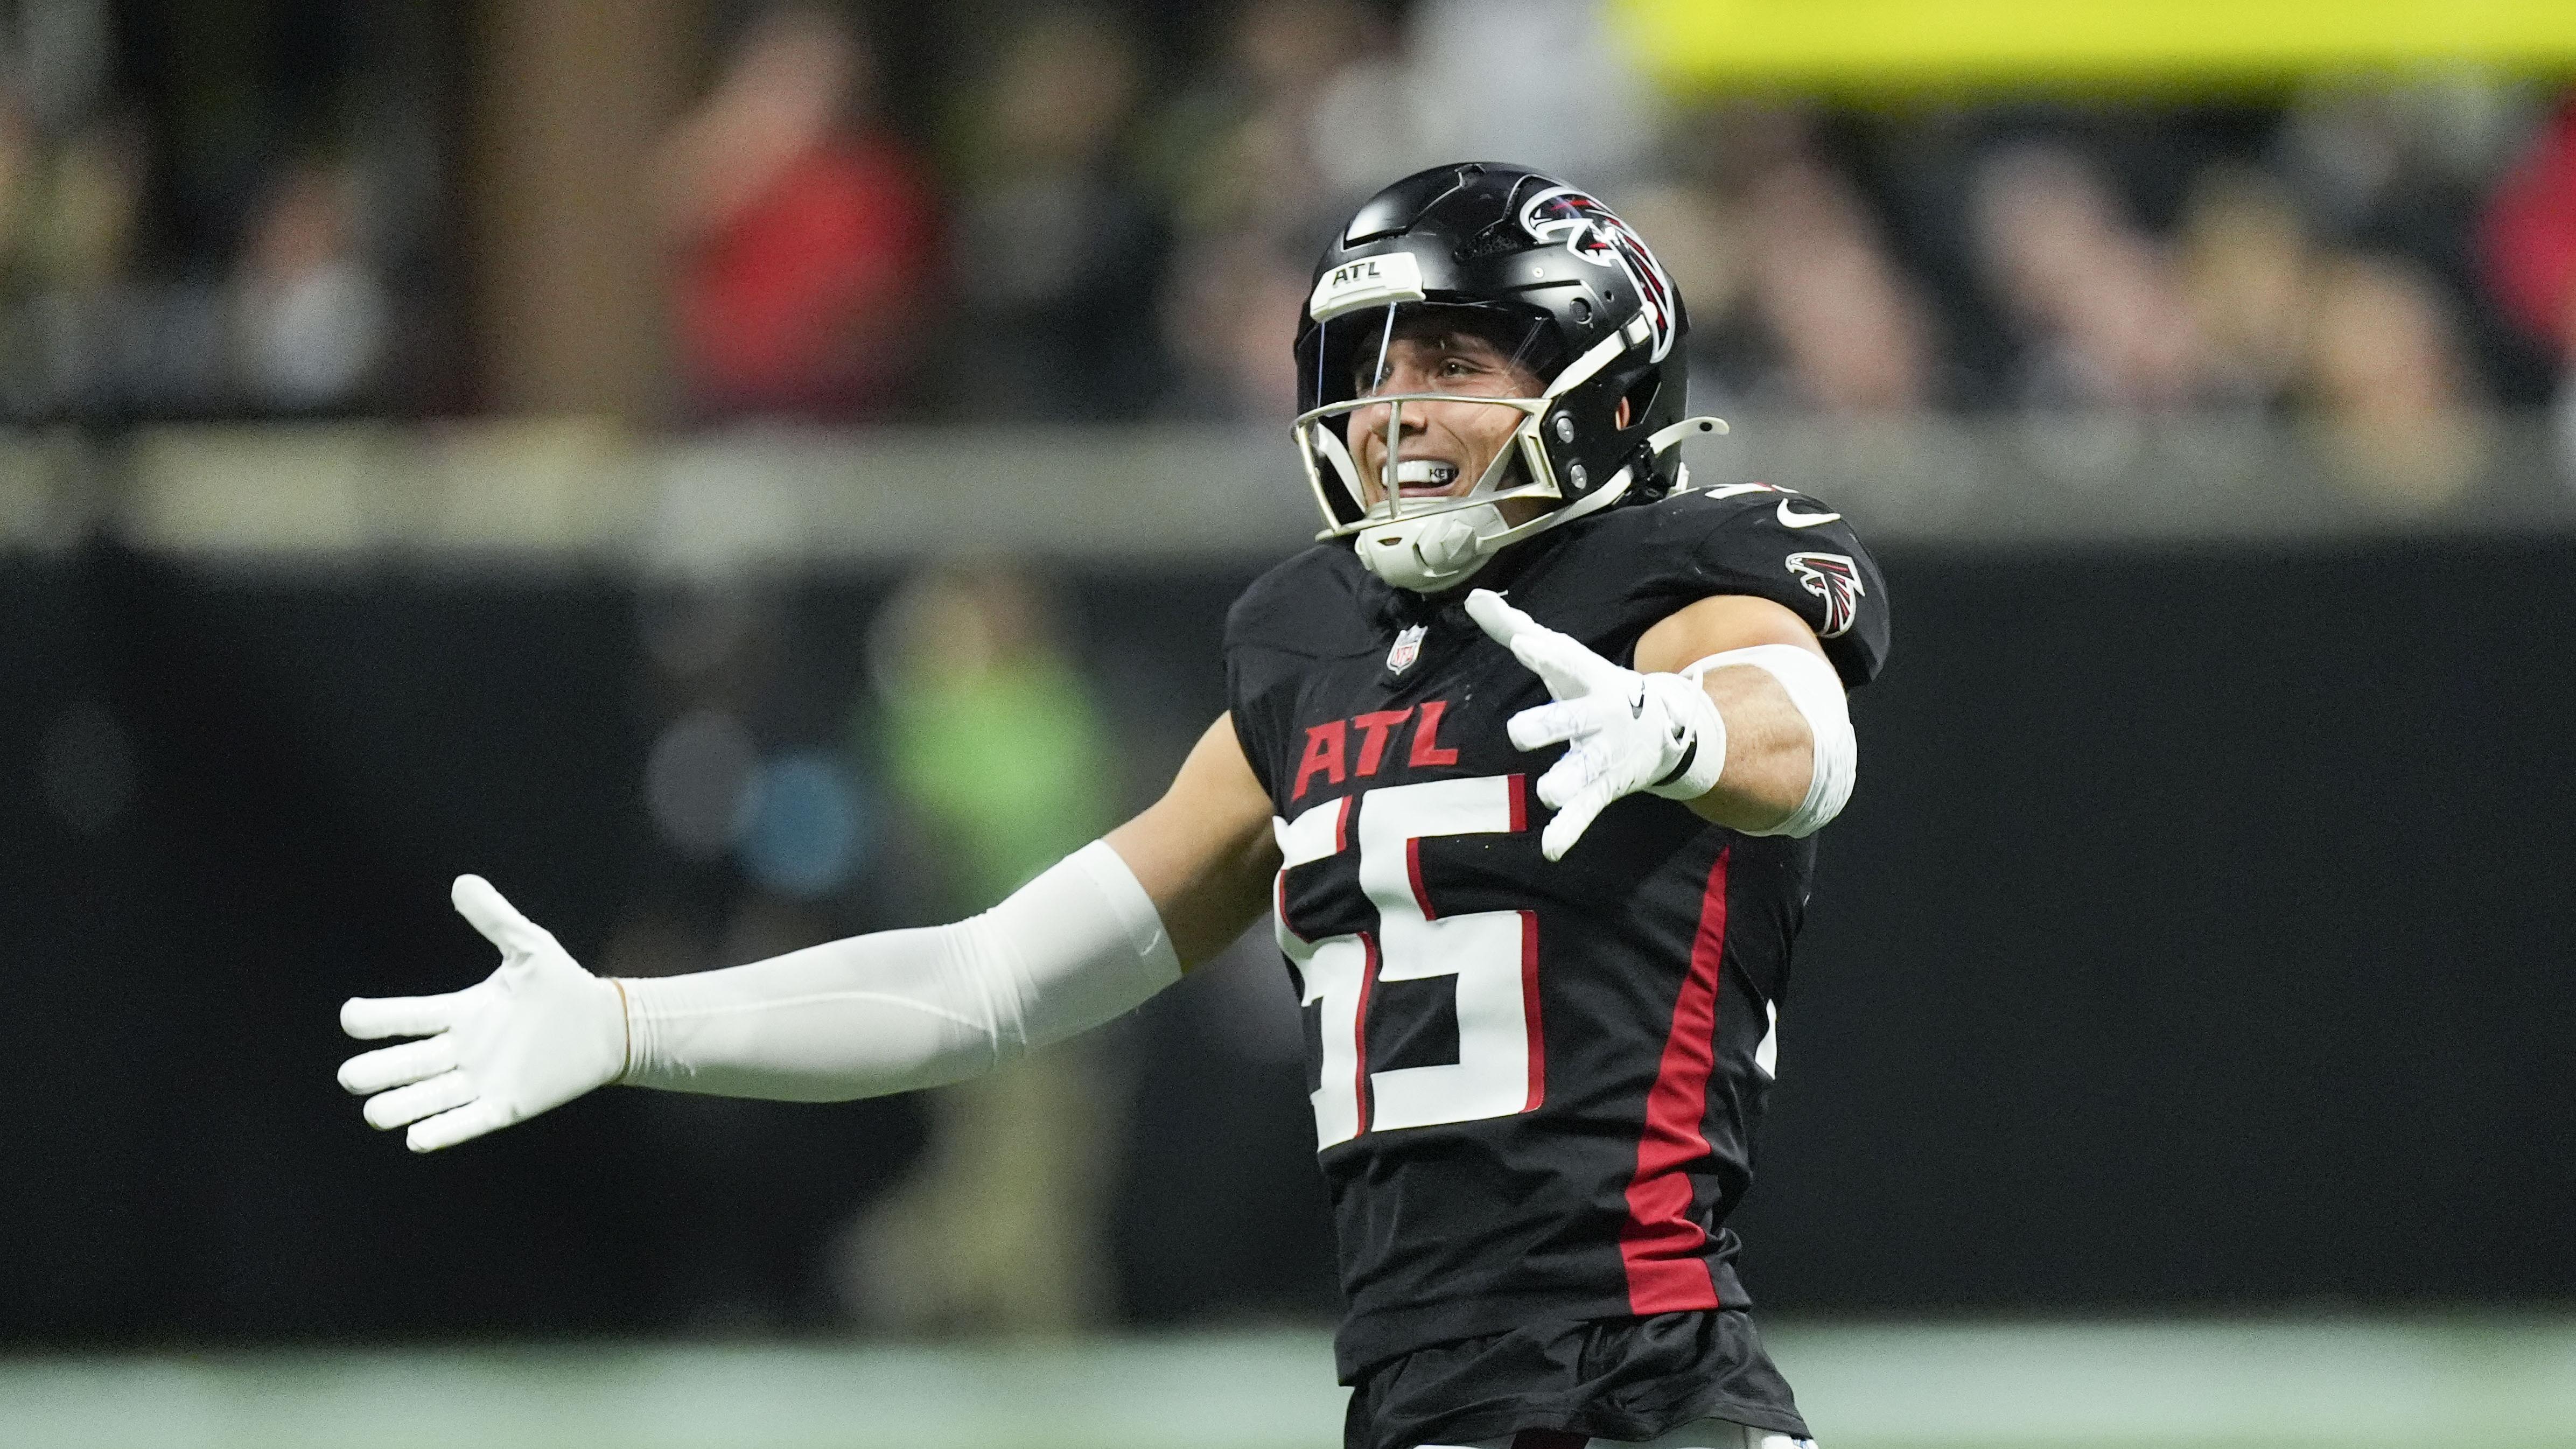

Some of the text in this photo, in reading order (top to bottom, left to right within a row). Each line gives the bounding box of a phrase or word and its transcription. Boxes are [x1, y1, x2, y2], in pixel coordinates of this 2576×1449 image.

[1333, 262, 1381, 286] ATL
[1293, 701, 1459, 801] ATL
[1273, 774, 1544, 1153] 55
